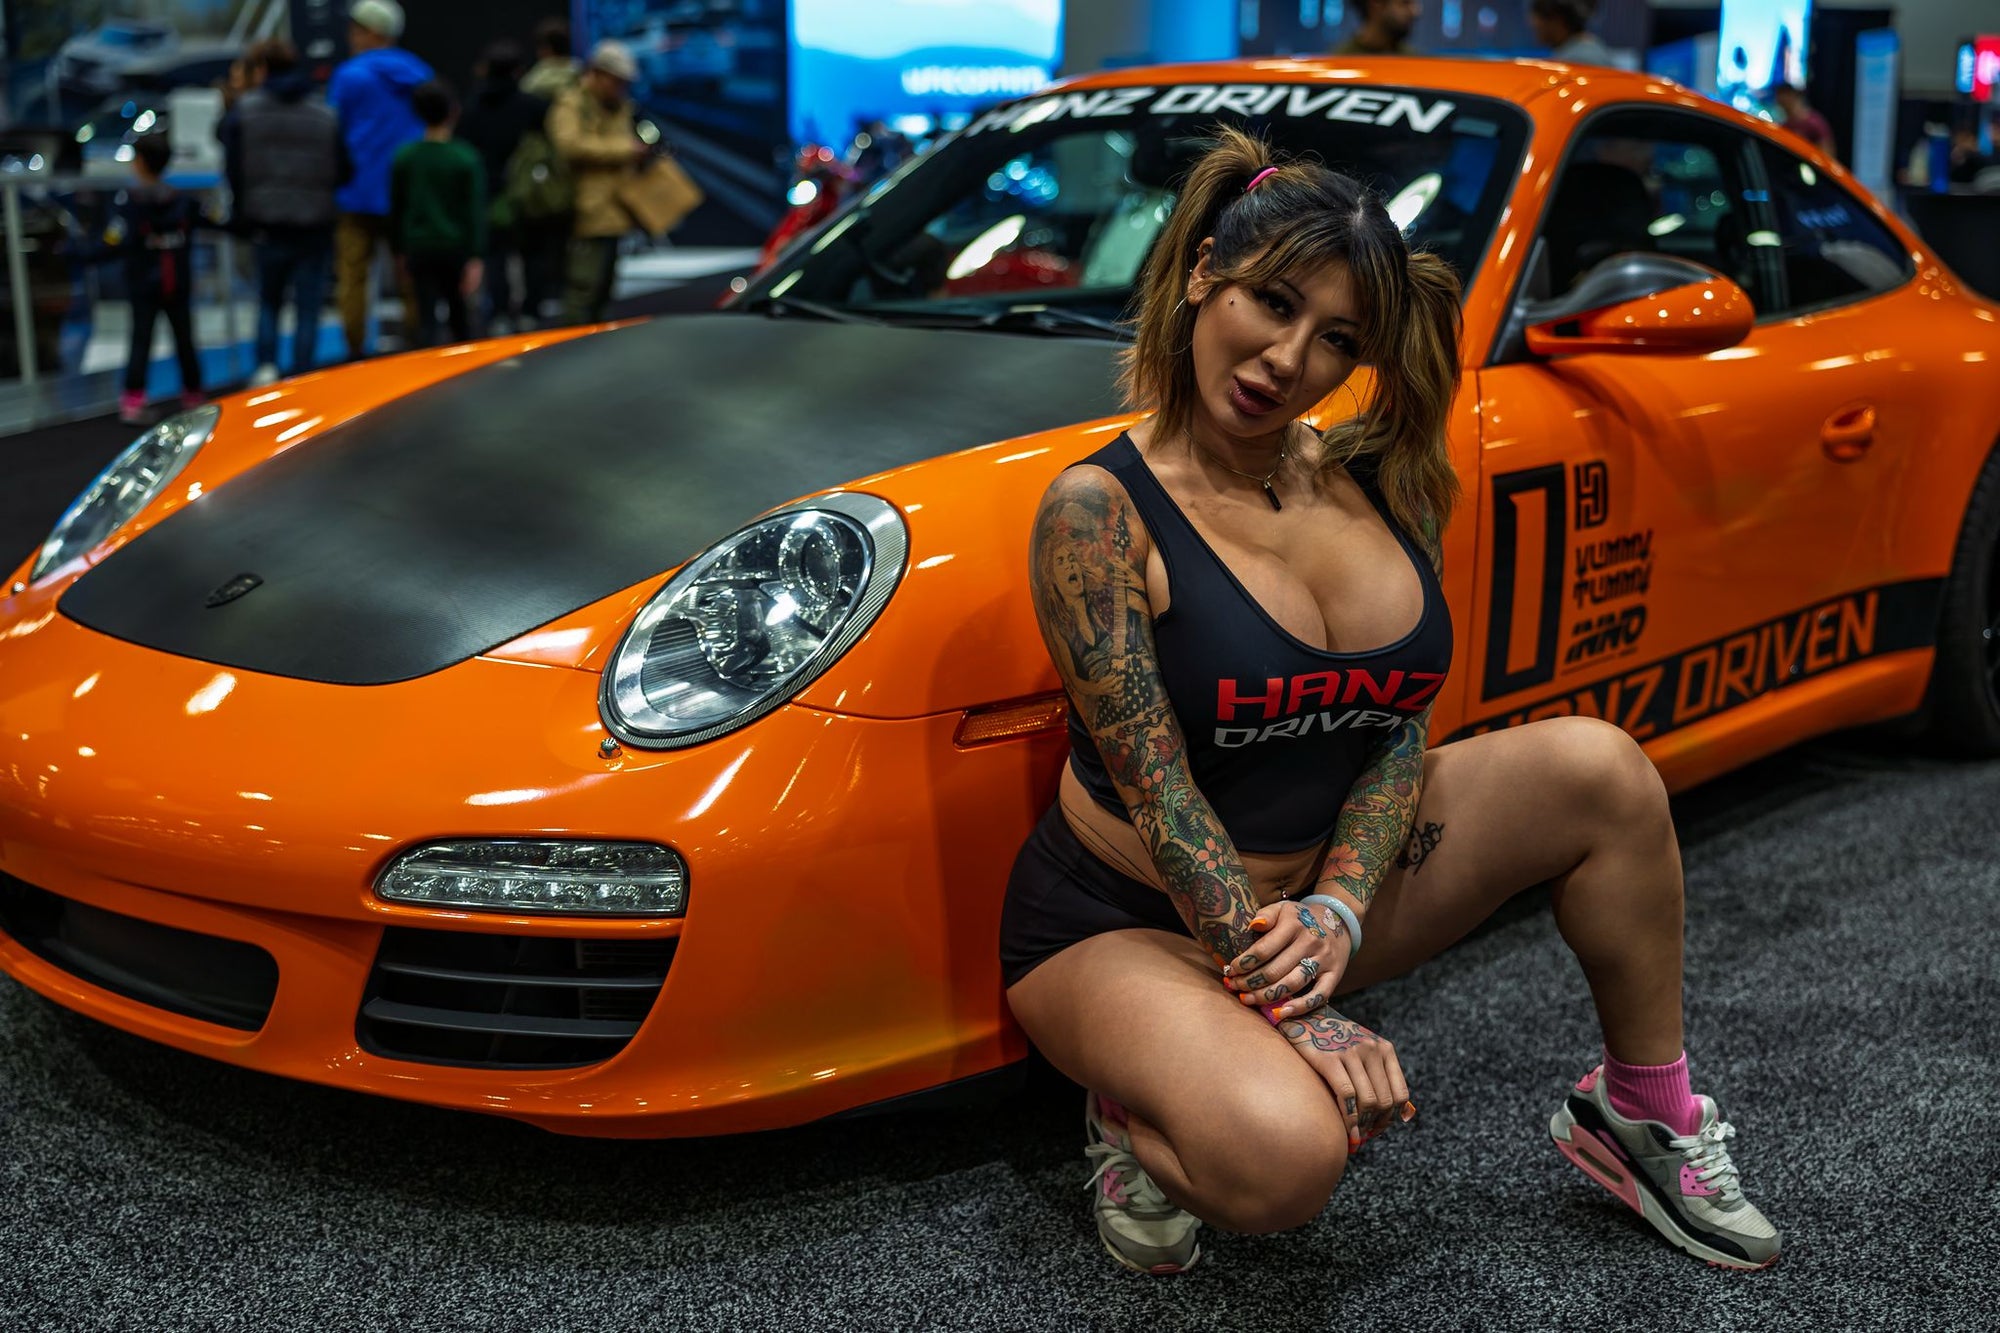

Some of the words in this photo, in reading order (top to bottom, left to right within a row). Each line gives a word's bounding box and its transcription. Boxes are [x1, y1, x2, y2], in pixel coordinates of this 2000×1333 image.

[1149, 84, 1455, 133] DRIVEN
[1671, 591, 1879, 725] DRIVEN
[1217, 669, 1447, 721] HANZ
